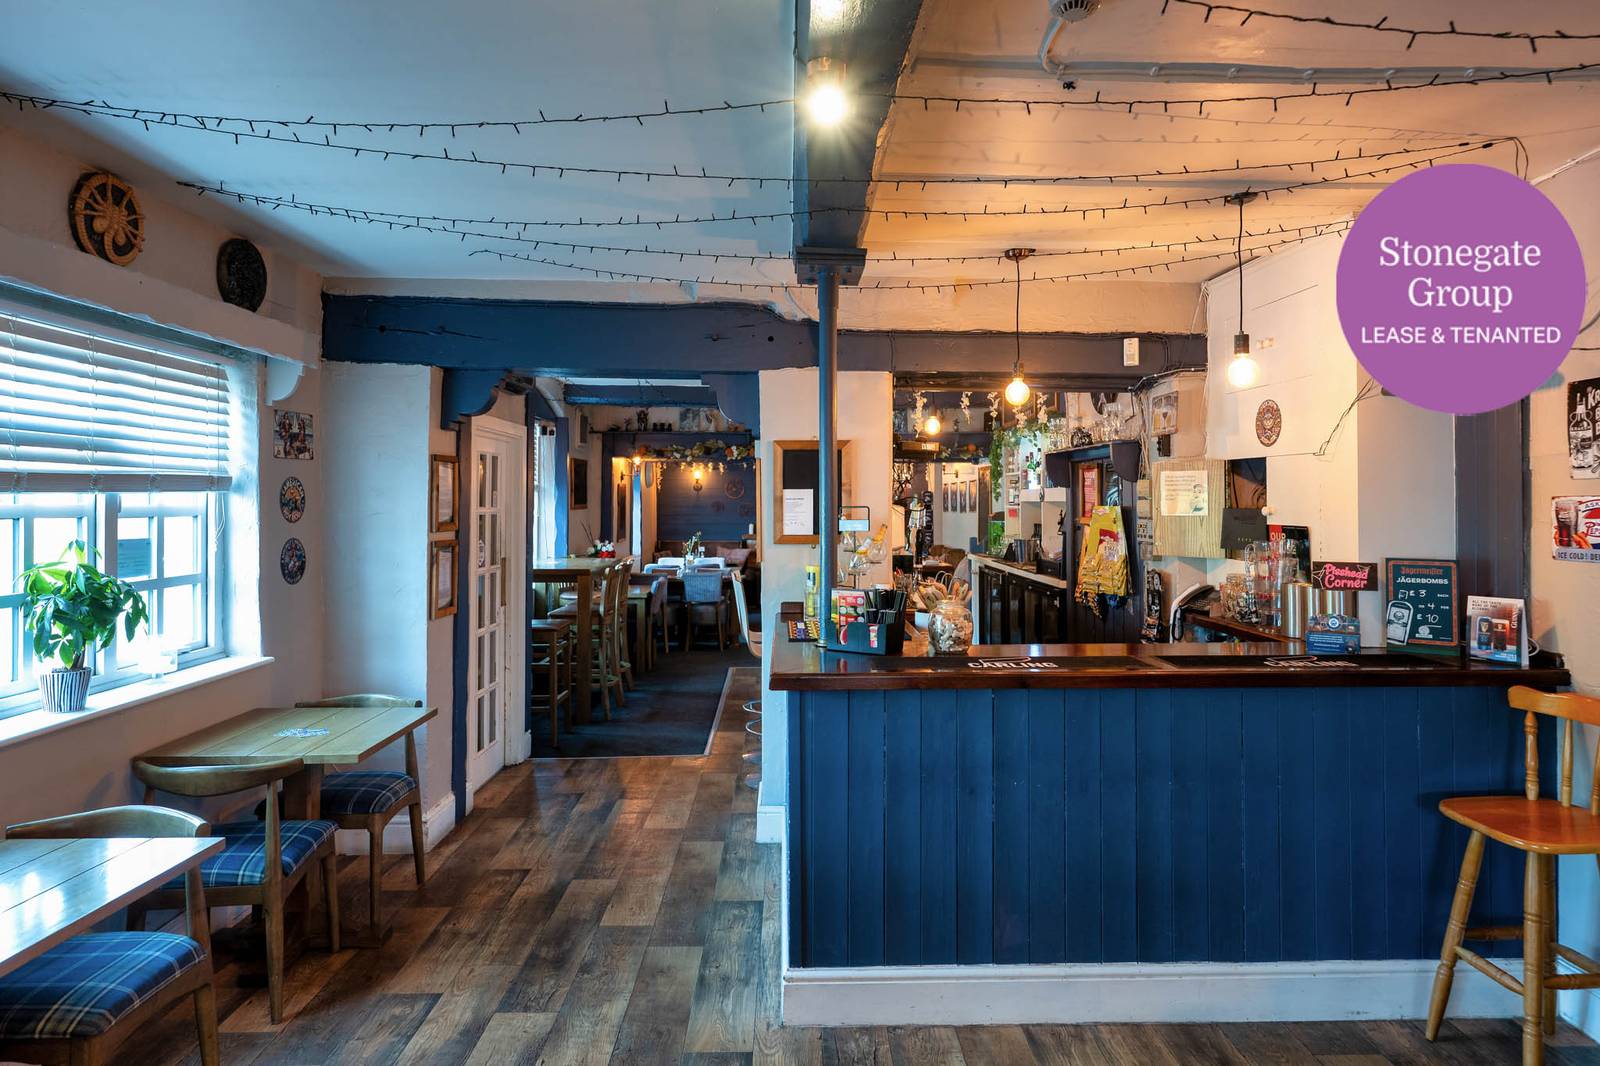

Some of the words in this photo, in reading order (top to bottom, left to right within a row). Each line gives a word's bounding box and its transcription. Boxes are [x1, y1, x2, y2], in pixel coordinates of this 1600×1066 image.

[1557, 551, 1568, 559] ICE
[1325, 574, 1368, 588] Corner
[1396, 576, 1449, 585] JÄGERBOMBS
[1425, 614, 1439, 623] 10
[967, 659, 1058, 668] CARLING
